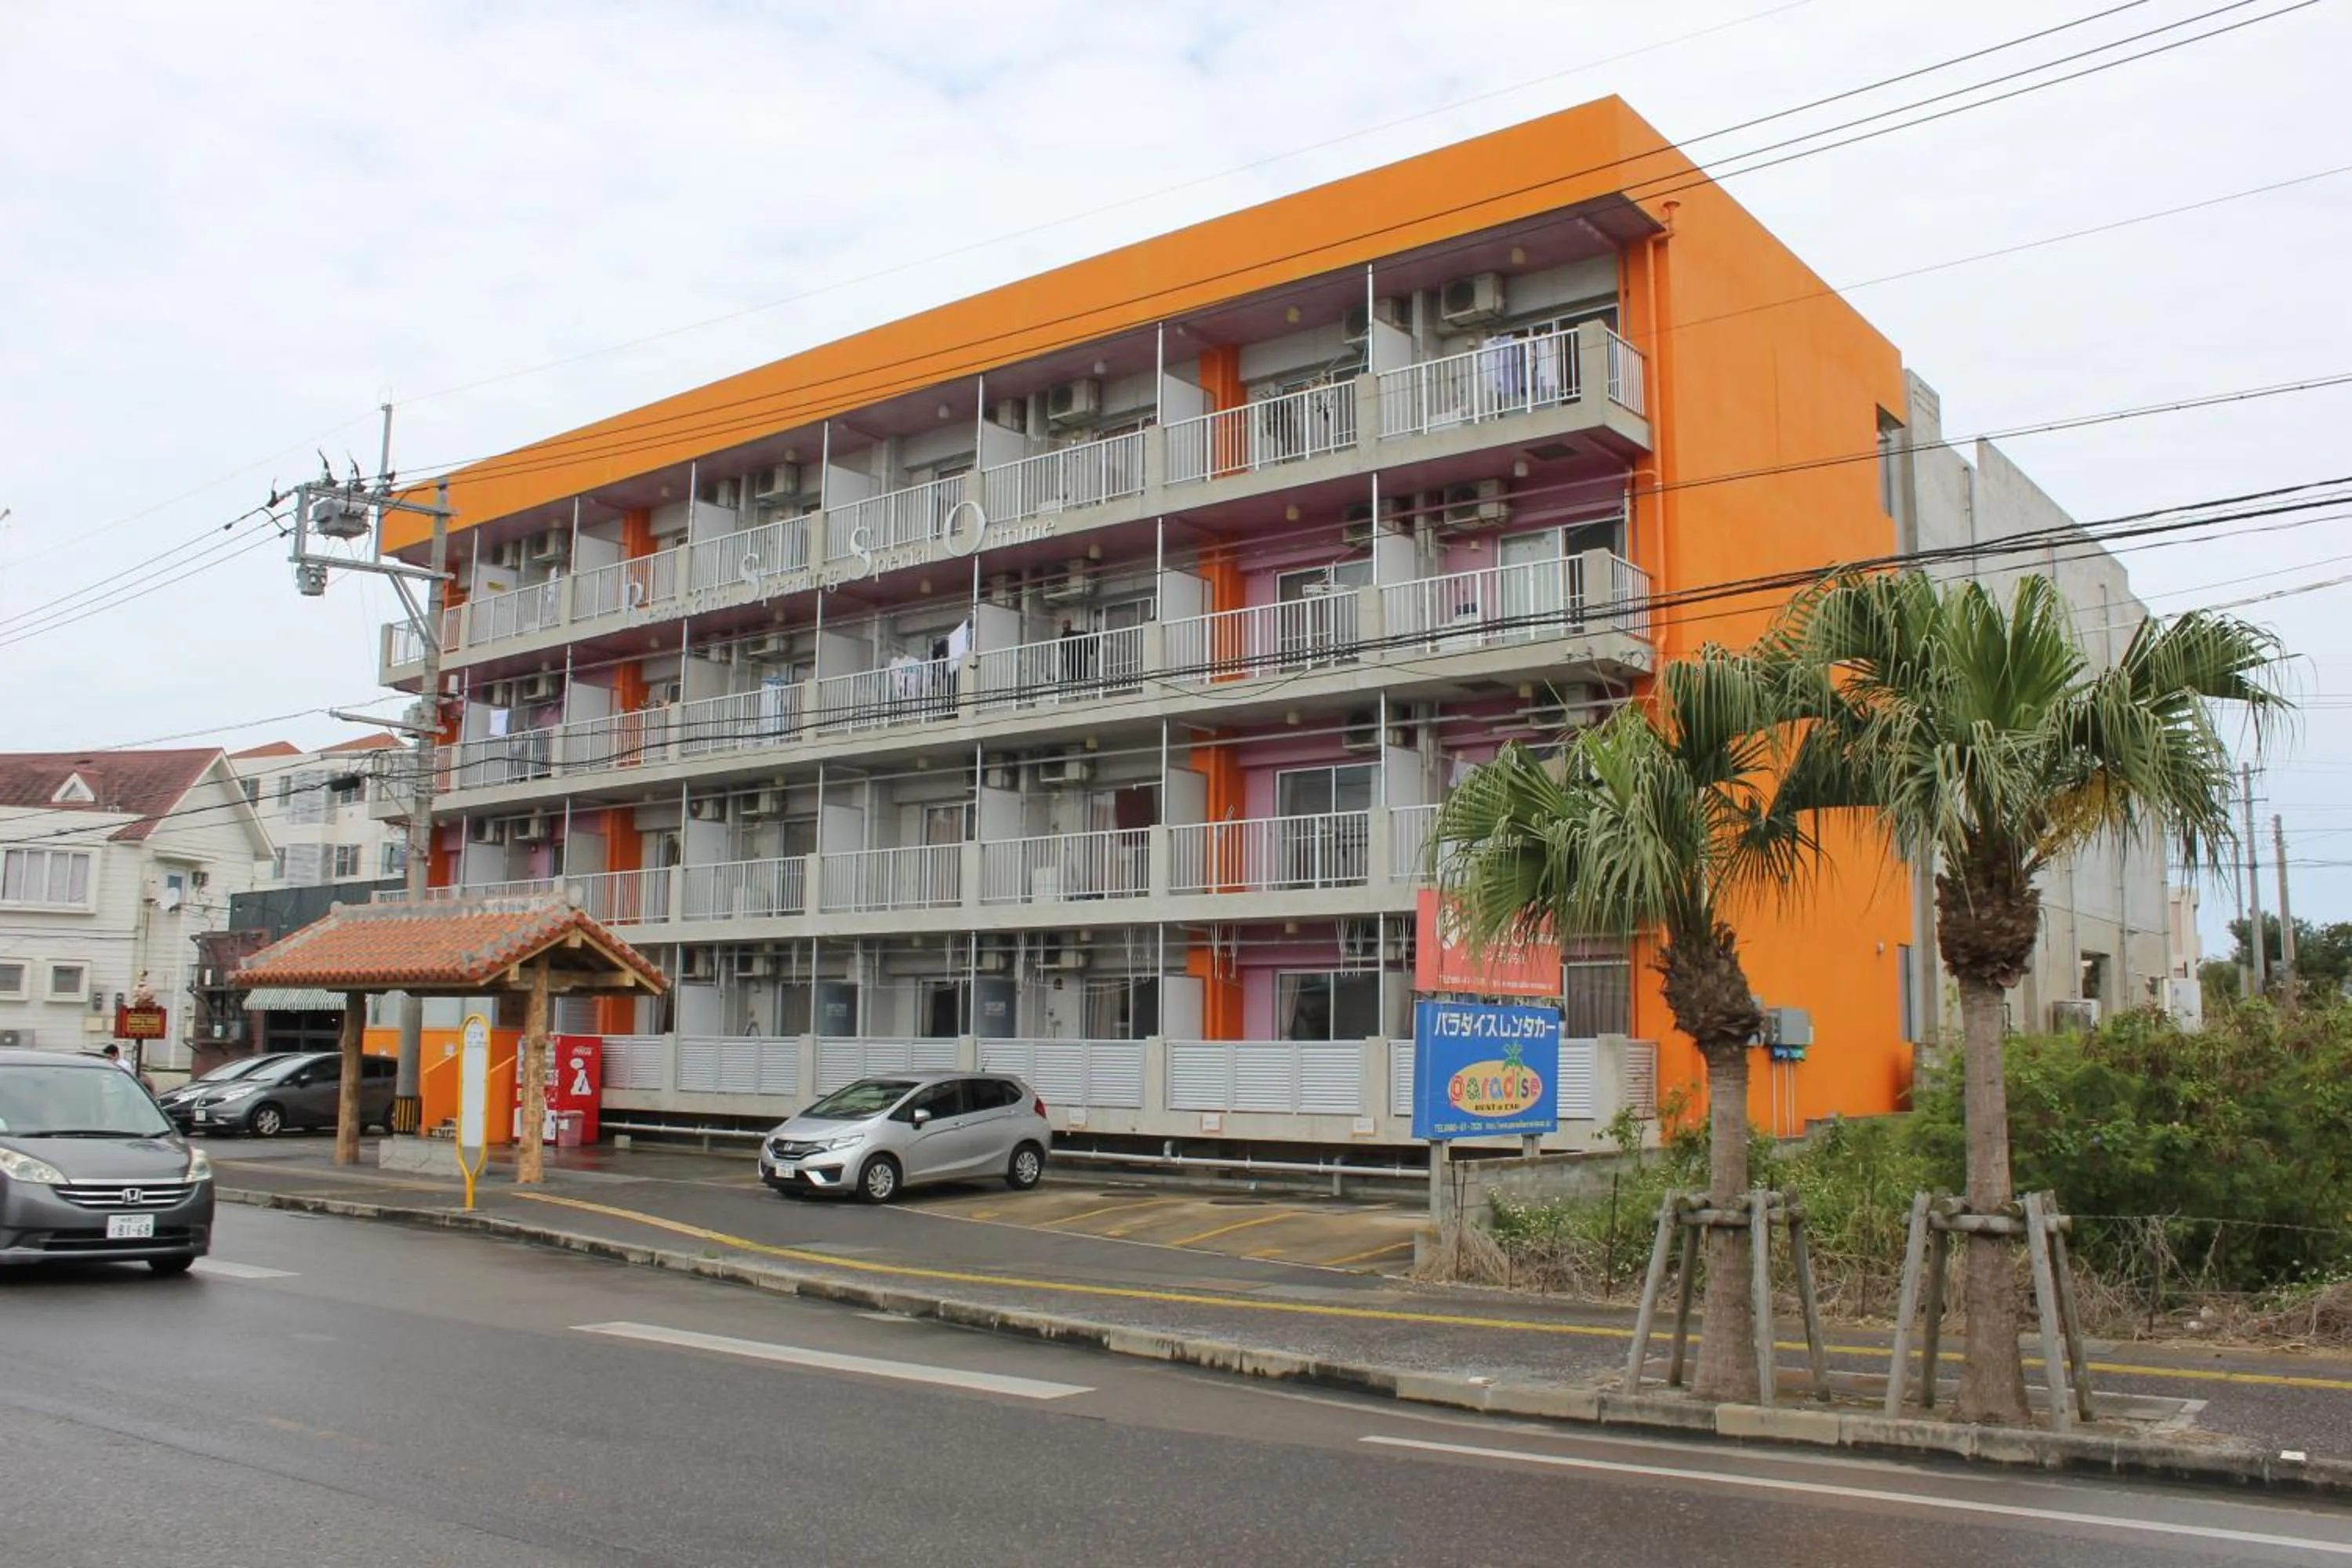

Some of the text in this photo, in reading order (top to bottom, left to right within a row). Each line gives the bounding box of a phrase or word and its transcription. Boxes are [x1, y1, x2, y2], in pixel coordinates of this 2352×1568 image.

[848, 526, 931, 583] Special
[1434, 1012, 1556, 1037] パラダイスレンタカー
